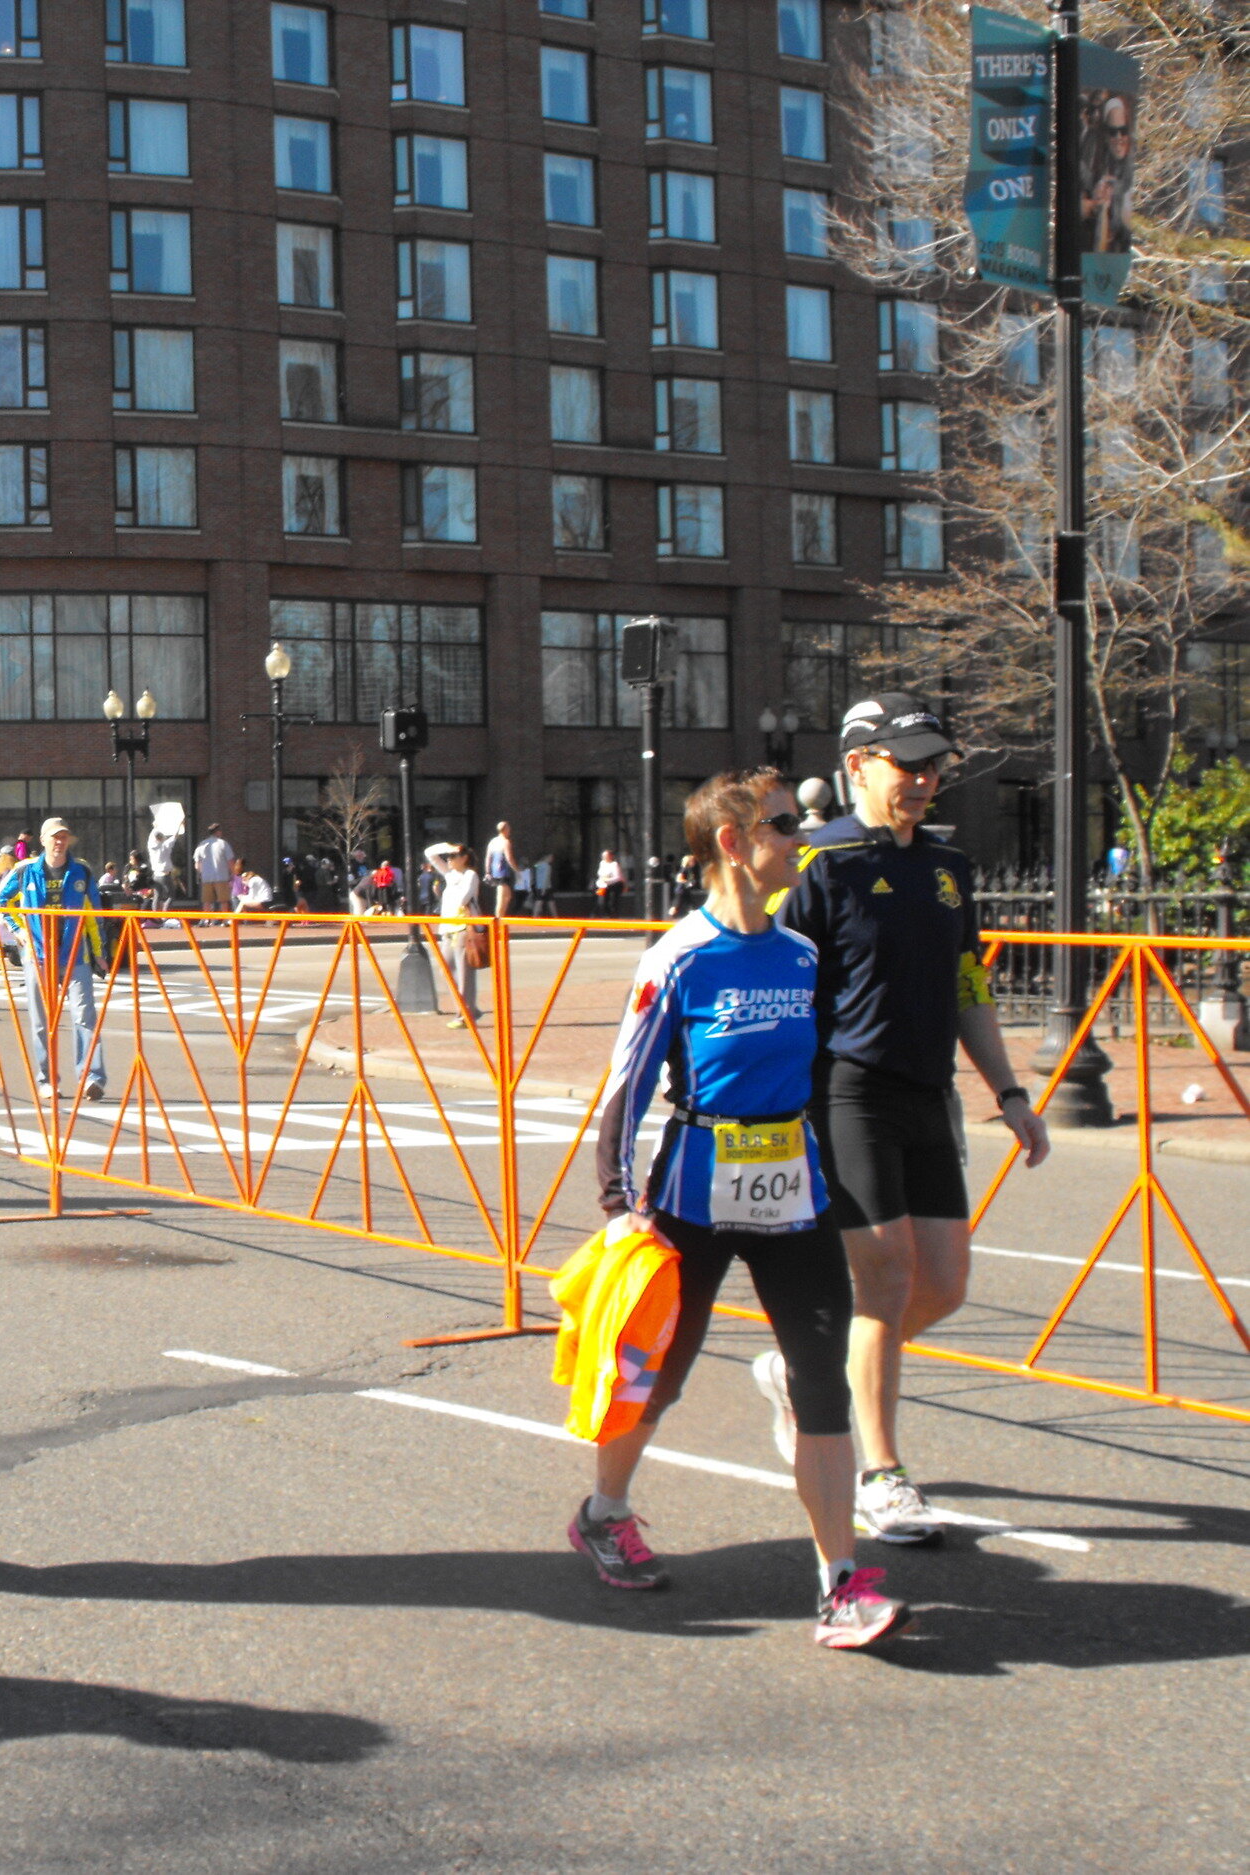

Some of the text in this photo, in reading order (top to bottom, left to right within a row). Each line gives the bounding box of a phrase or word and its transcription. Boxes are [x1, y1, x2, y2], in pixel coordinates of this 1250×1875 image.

[976, 53, 1047, 78] THERE'S
[987, 116, 1036, 141] ONLY
[989, 176, 1034, 201] ONE
[733, 1002, 811, 1022] CHOICE
[771, 1132, 790, 1147] 5K
[731, 1169, 800, 1201] 1604
